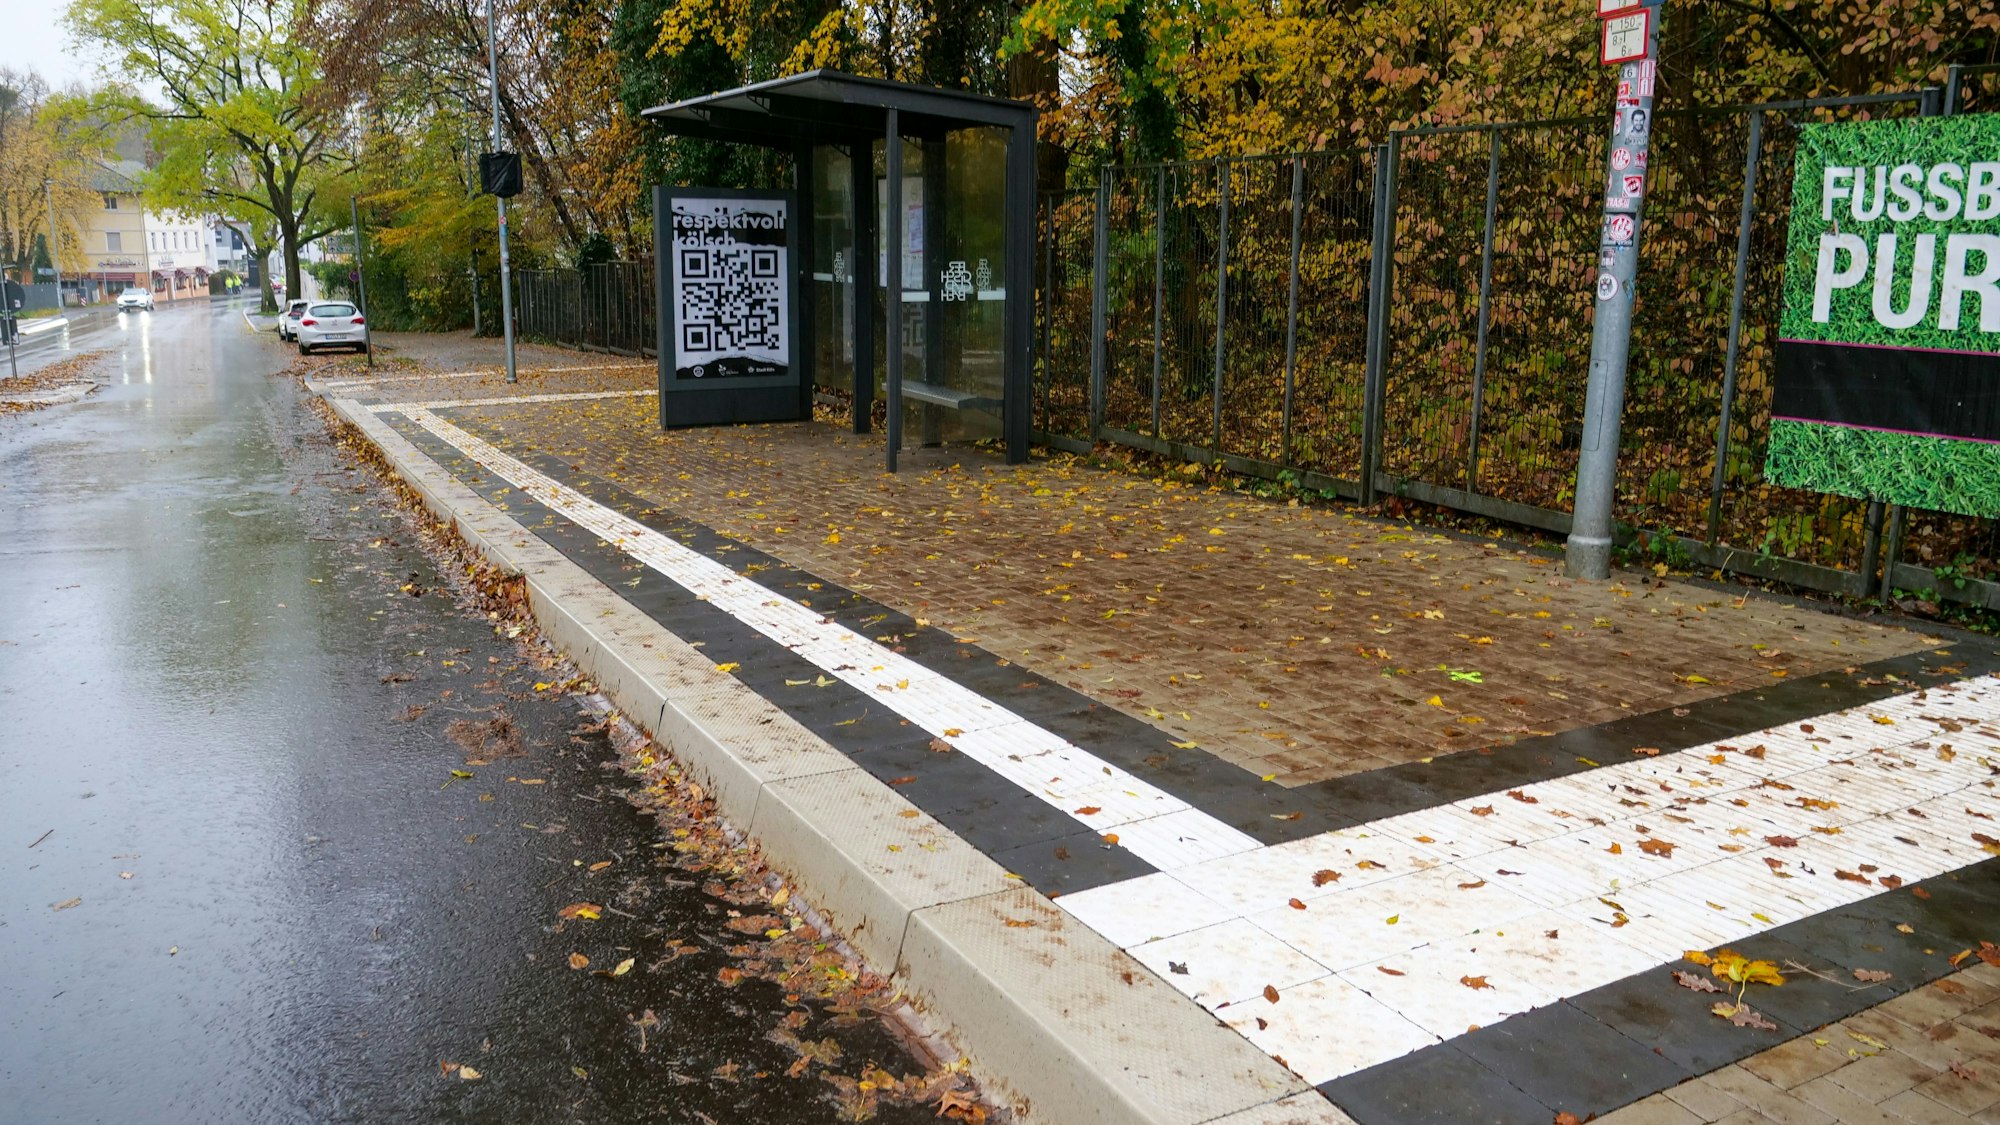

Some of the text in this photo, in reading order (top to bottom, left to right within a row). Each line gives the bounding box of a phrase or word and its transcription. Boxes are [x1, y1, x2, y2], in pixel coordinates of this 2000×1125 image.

[1607, 16, 1636, 31] H 150
[1822, 162, 2000, 222] FUSSB
[672, 210, 785, 233] respektvoll
[673, 230, 736, 248] kölsch
[1812, 232, 2000, 333] PUR
